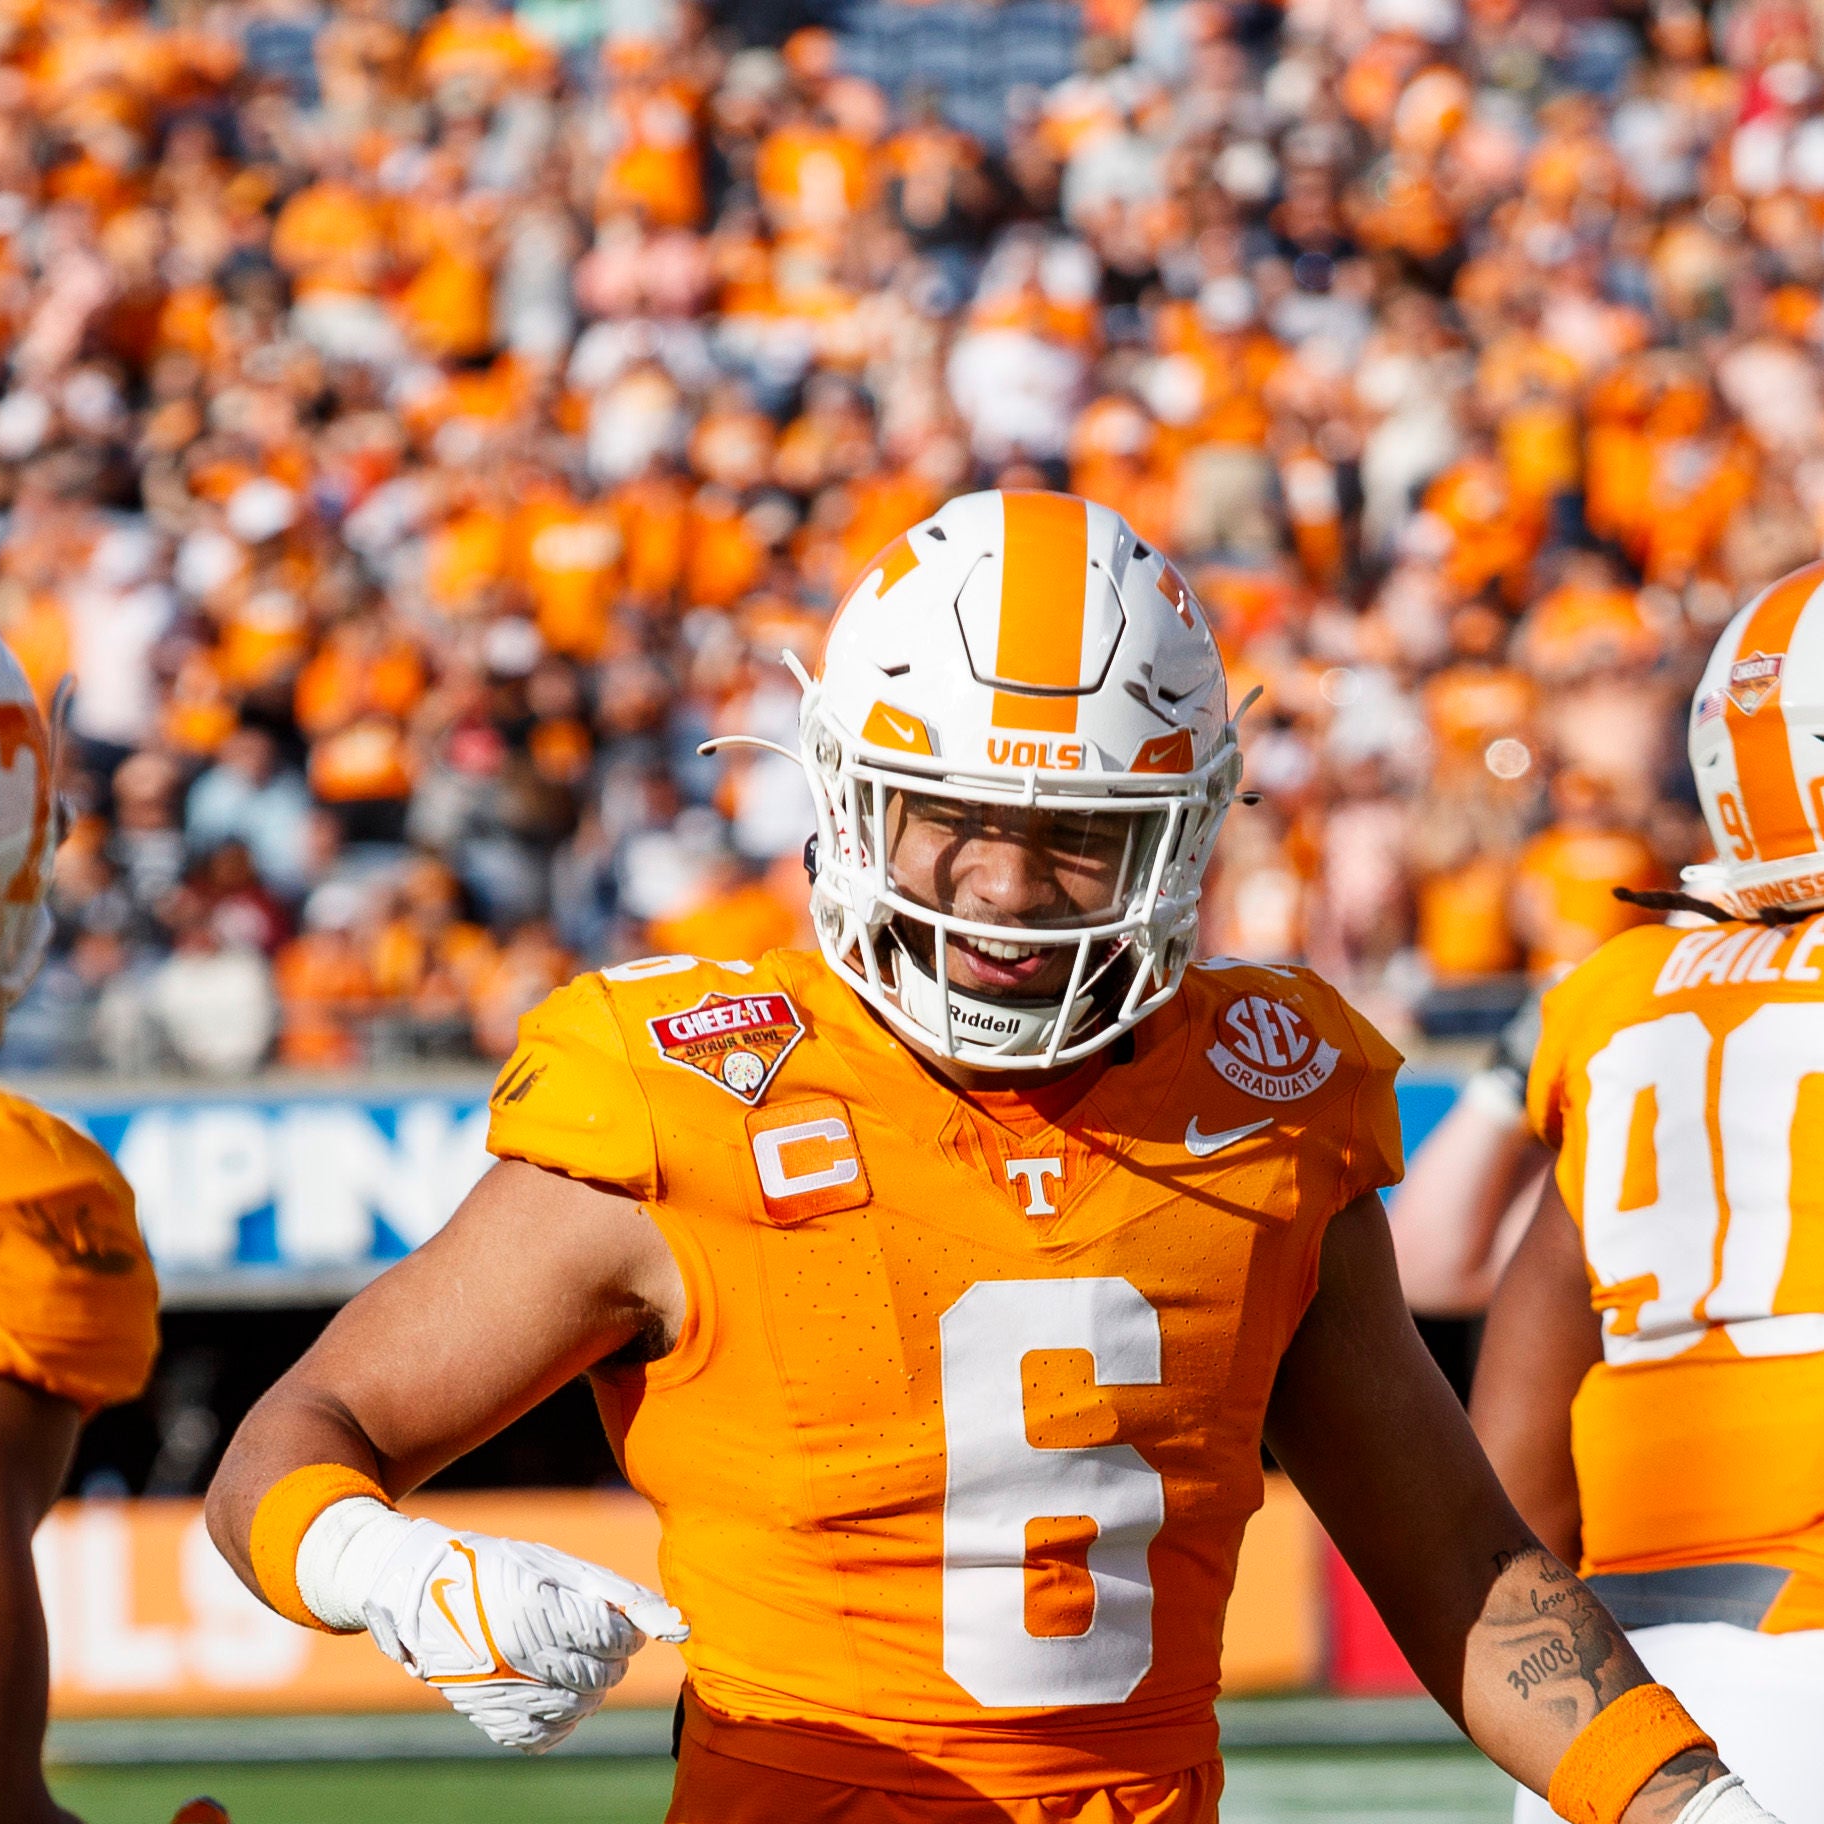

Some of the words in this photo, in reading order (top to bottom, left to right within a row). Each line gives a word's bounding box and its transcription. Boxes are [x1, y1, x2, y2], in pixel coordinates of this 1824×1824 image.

[987, 738, 1081, 771] VOLS
[1717, 792, 1754, 861] 9
[685, 1036, 738, 1058] CITRUS
[743, 1028, 784, 1045] BOWL
[949, 1004, 1021, 1034] Riddell
[1226, 996, 1309, 1067] SEC
[1225, 1062, 1325, 1097] GRADUATE
[753, 1117, 859, 1199] C
[1006, 1157, 1062, 1216] T
[939, 1277, 1165, 1708] 6
[1507, 1638, 1574, 1700] 30108
